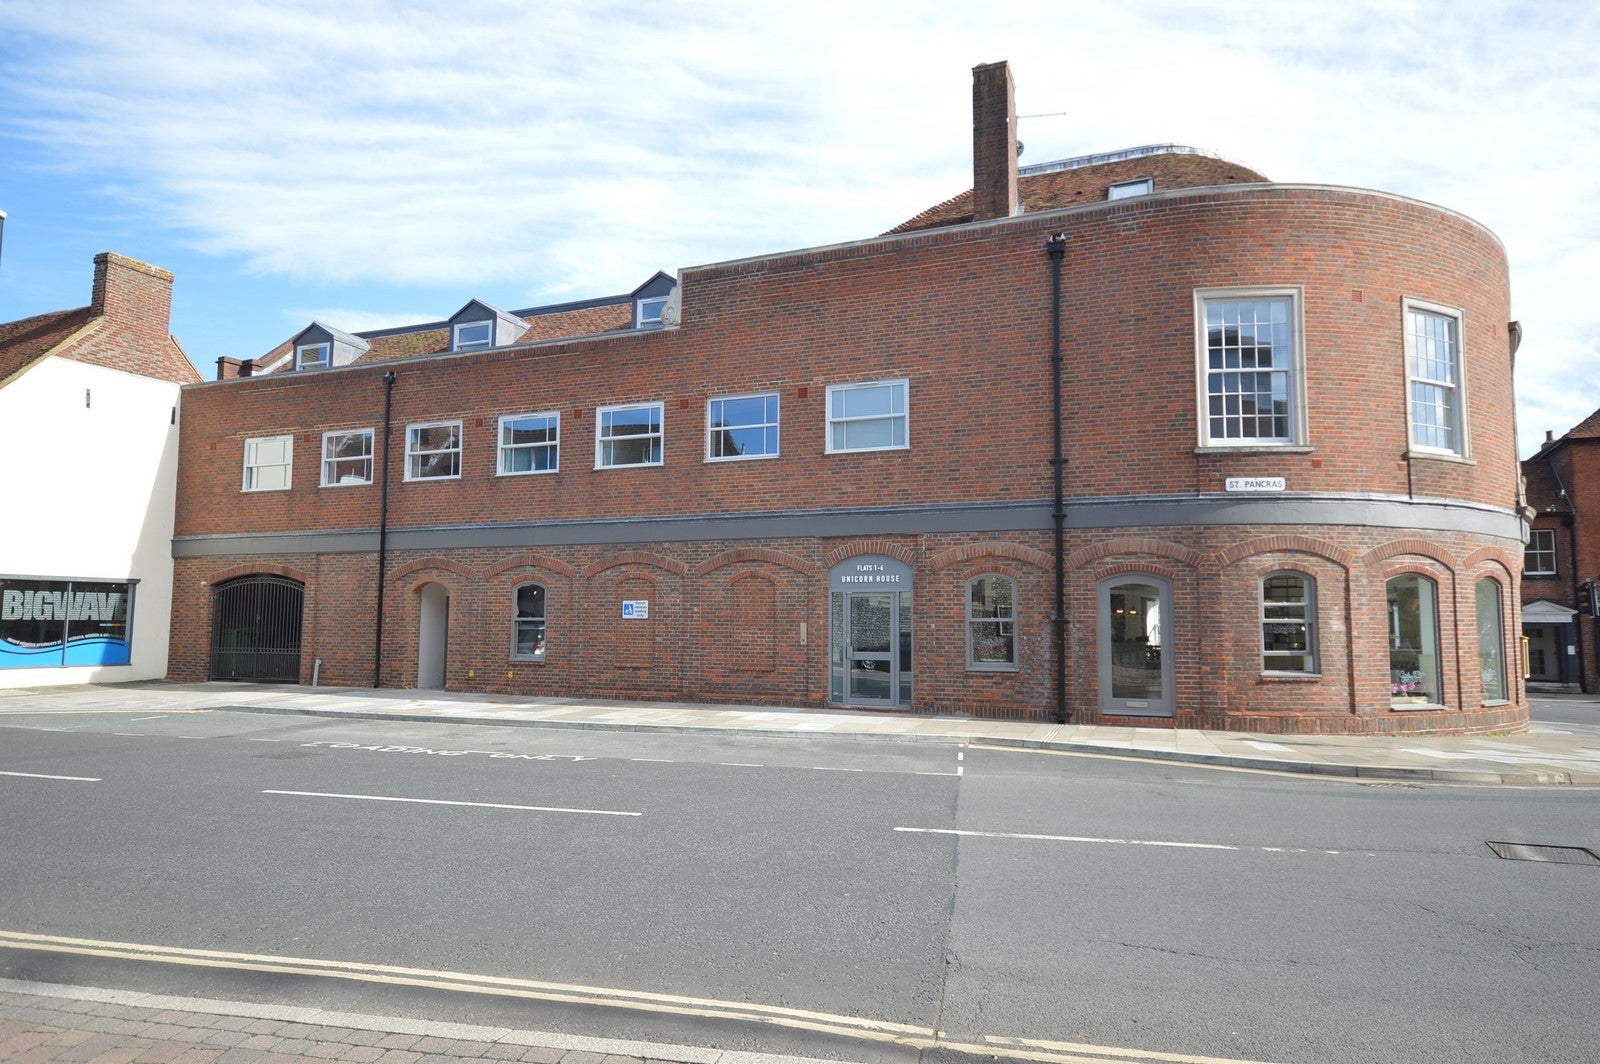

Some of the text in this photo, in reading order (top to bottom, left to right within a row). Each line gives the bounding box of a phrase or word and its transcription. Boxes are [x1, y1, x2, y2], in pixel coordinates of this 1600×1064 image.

[856, 564, 873, 572] FLATS
[841, 574, 901, 583] UNICORN HOUSE
